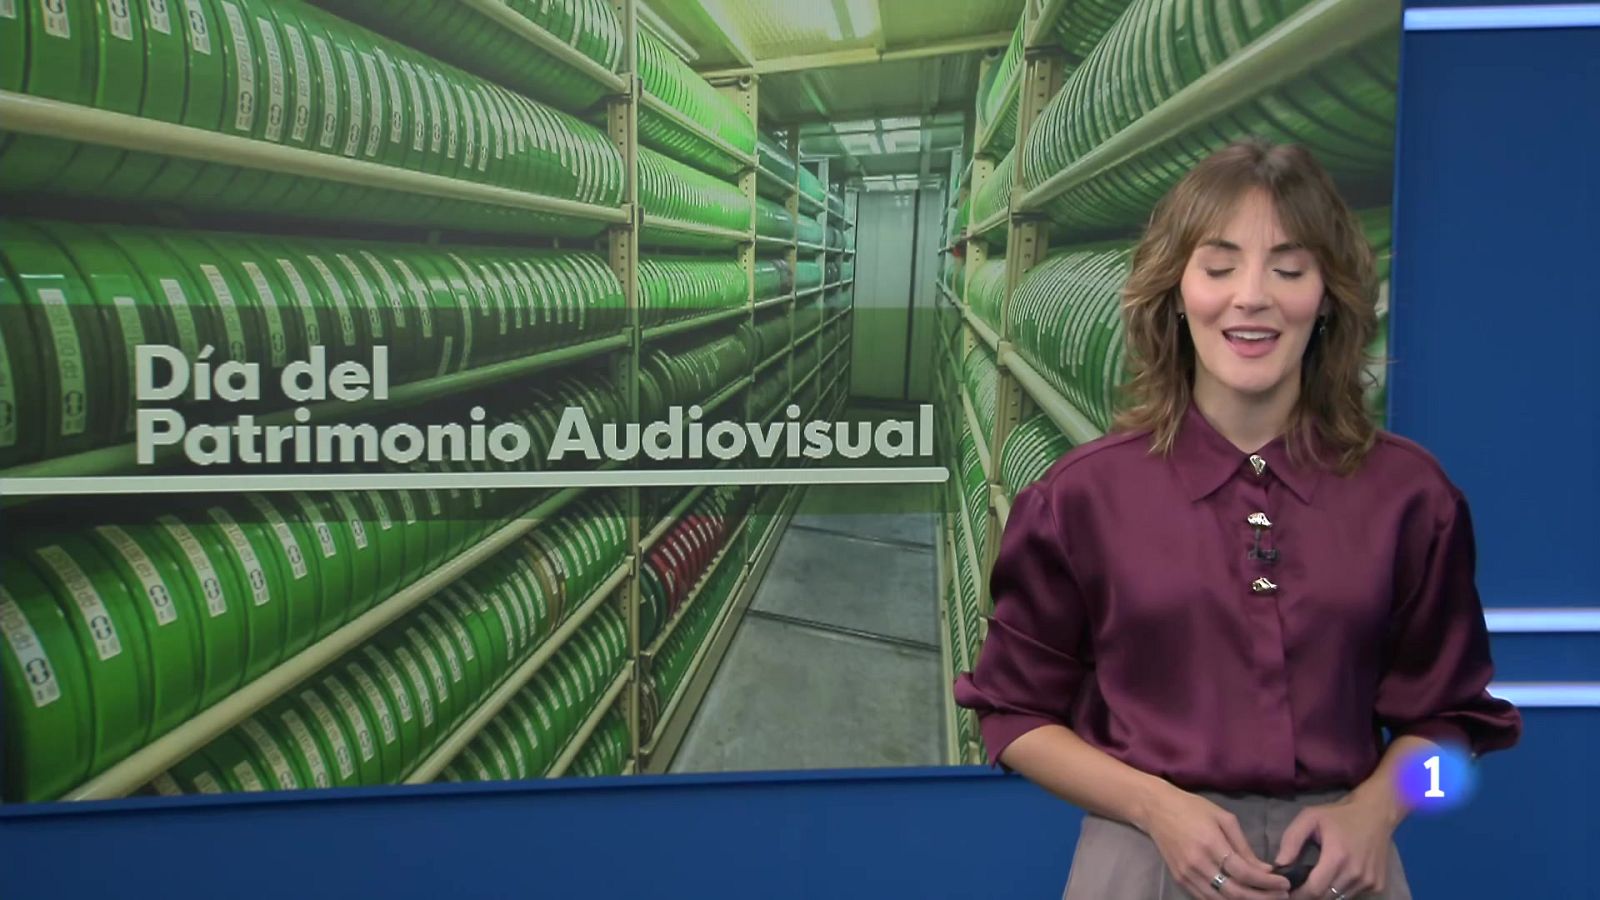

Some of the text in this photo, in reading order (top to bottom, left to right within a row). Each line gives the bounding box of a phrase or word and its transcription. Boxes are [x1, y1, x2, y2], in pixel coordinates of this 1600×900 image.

[135, 344, 389, 401] Día del
[136, 404, 933, 466] Patrimonio Audiovisual
